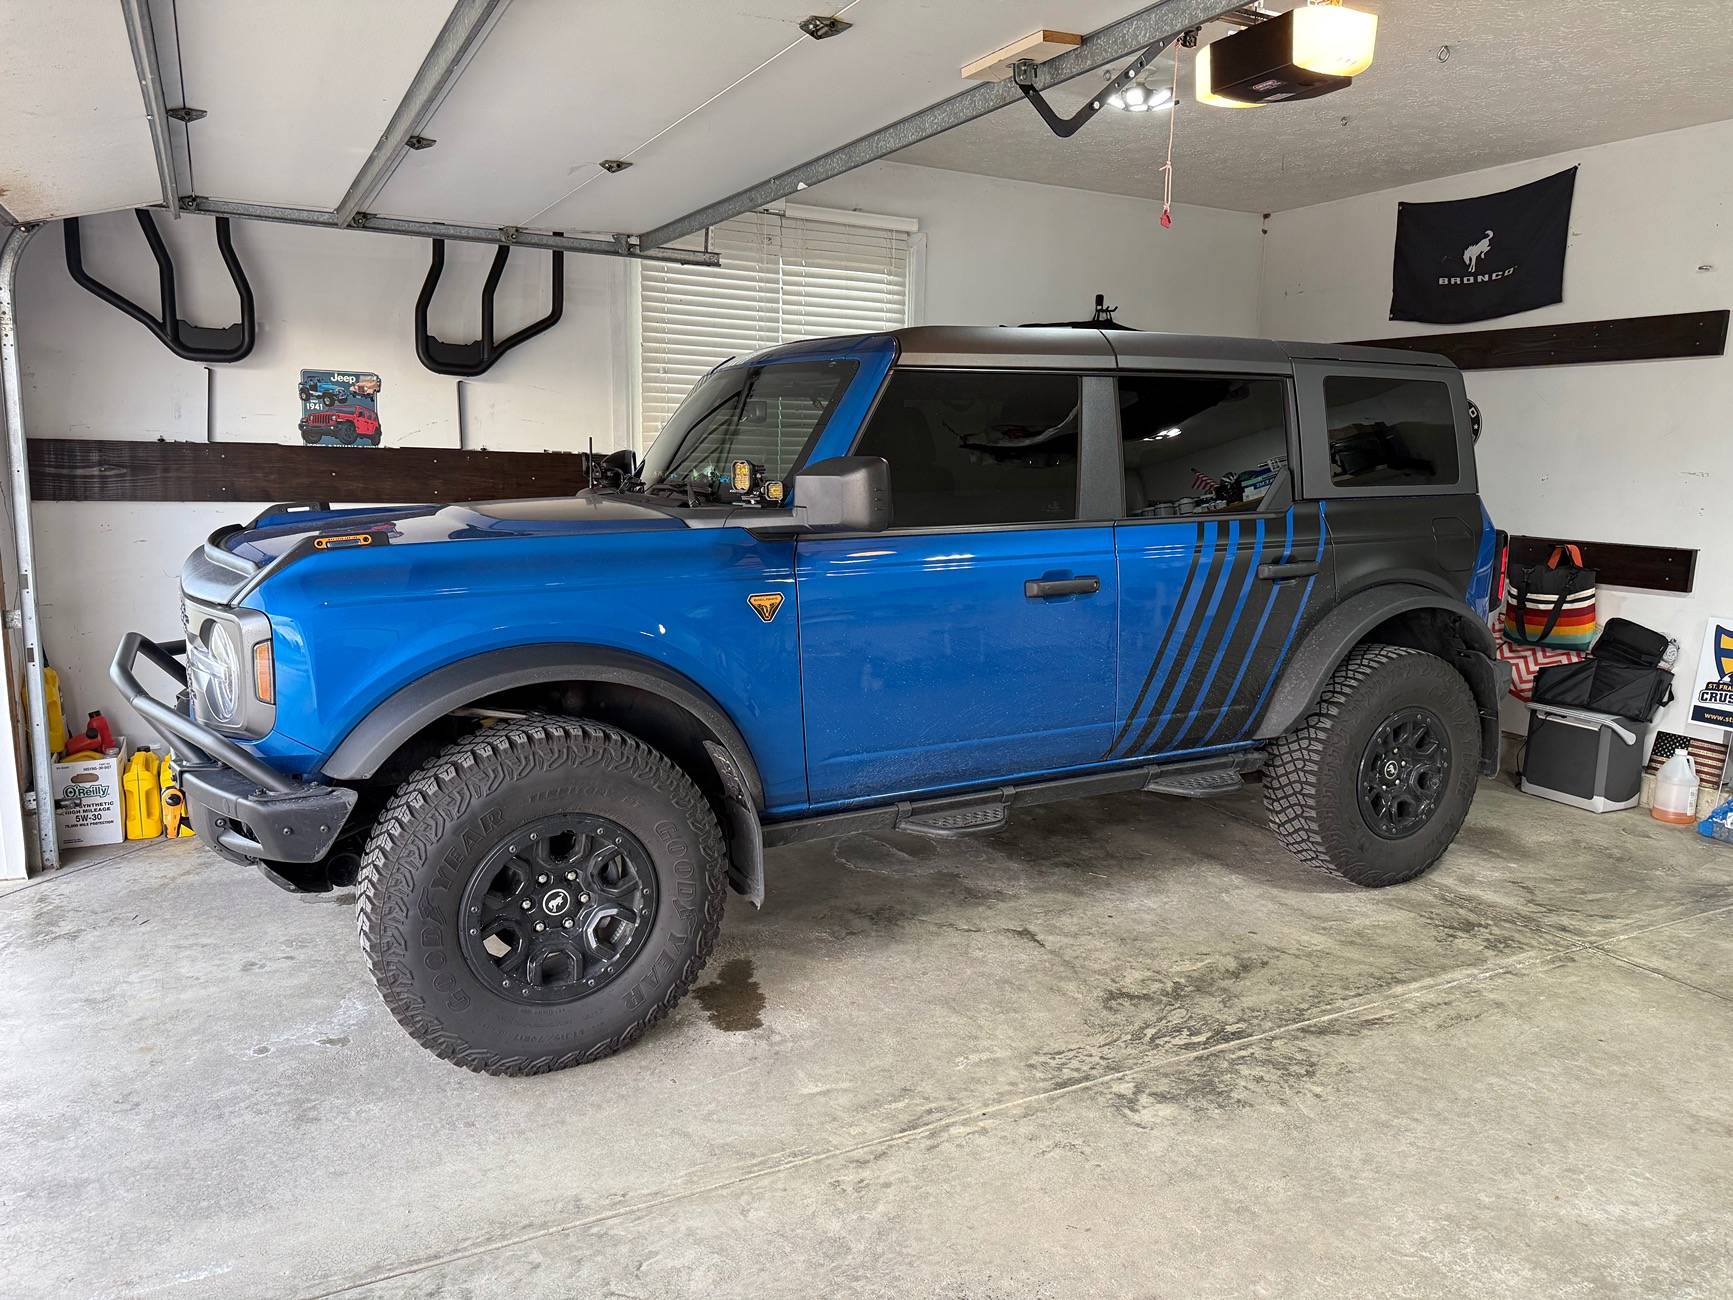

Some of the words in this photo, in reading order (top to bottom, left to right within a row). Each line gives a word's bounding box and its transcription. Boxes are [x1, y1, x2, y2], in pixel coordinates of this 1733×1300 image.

[1439, 266, 1515, 285] BRONCO
[331, 373, 356, 384] Jeep
[306, 402, 323, 411] 1941
[1701, 692, 1733, 704] CRUS
[1704, 713, 1733, 723] www.st
[65, 785, 109, 799] O'Reilly
[75, 813, 102, 823] 5W-30
